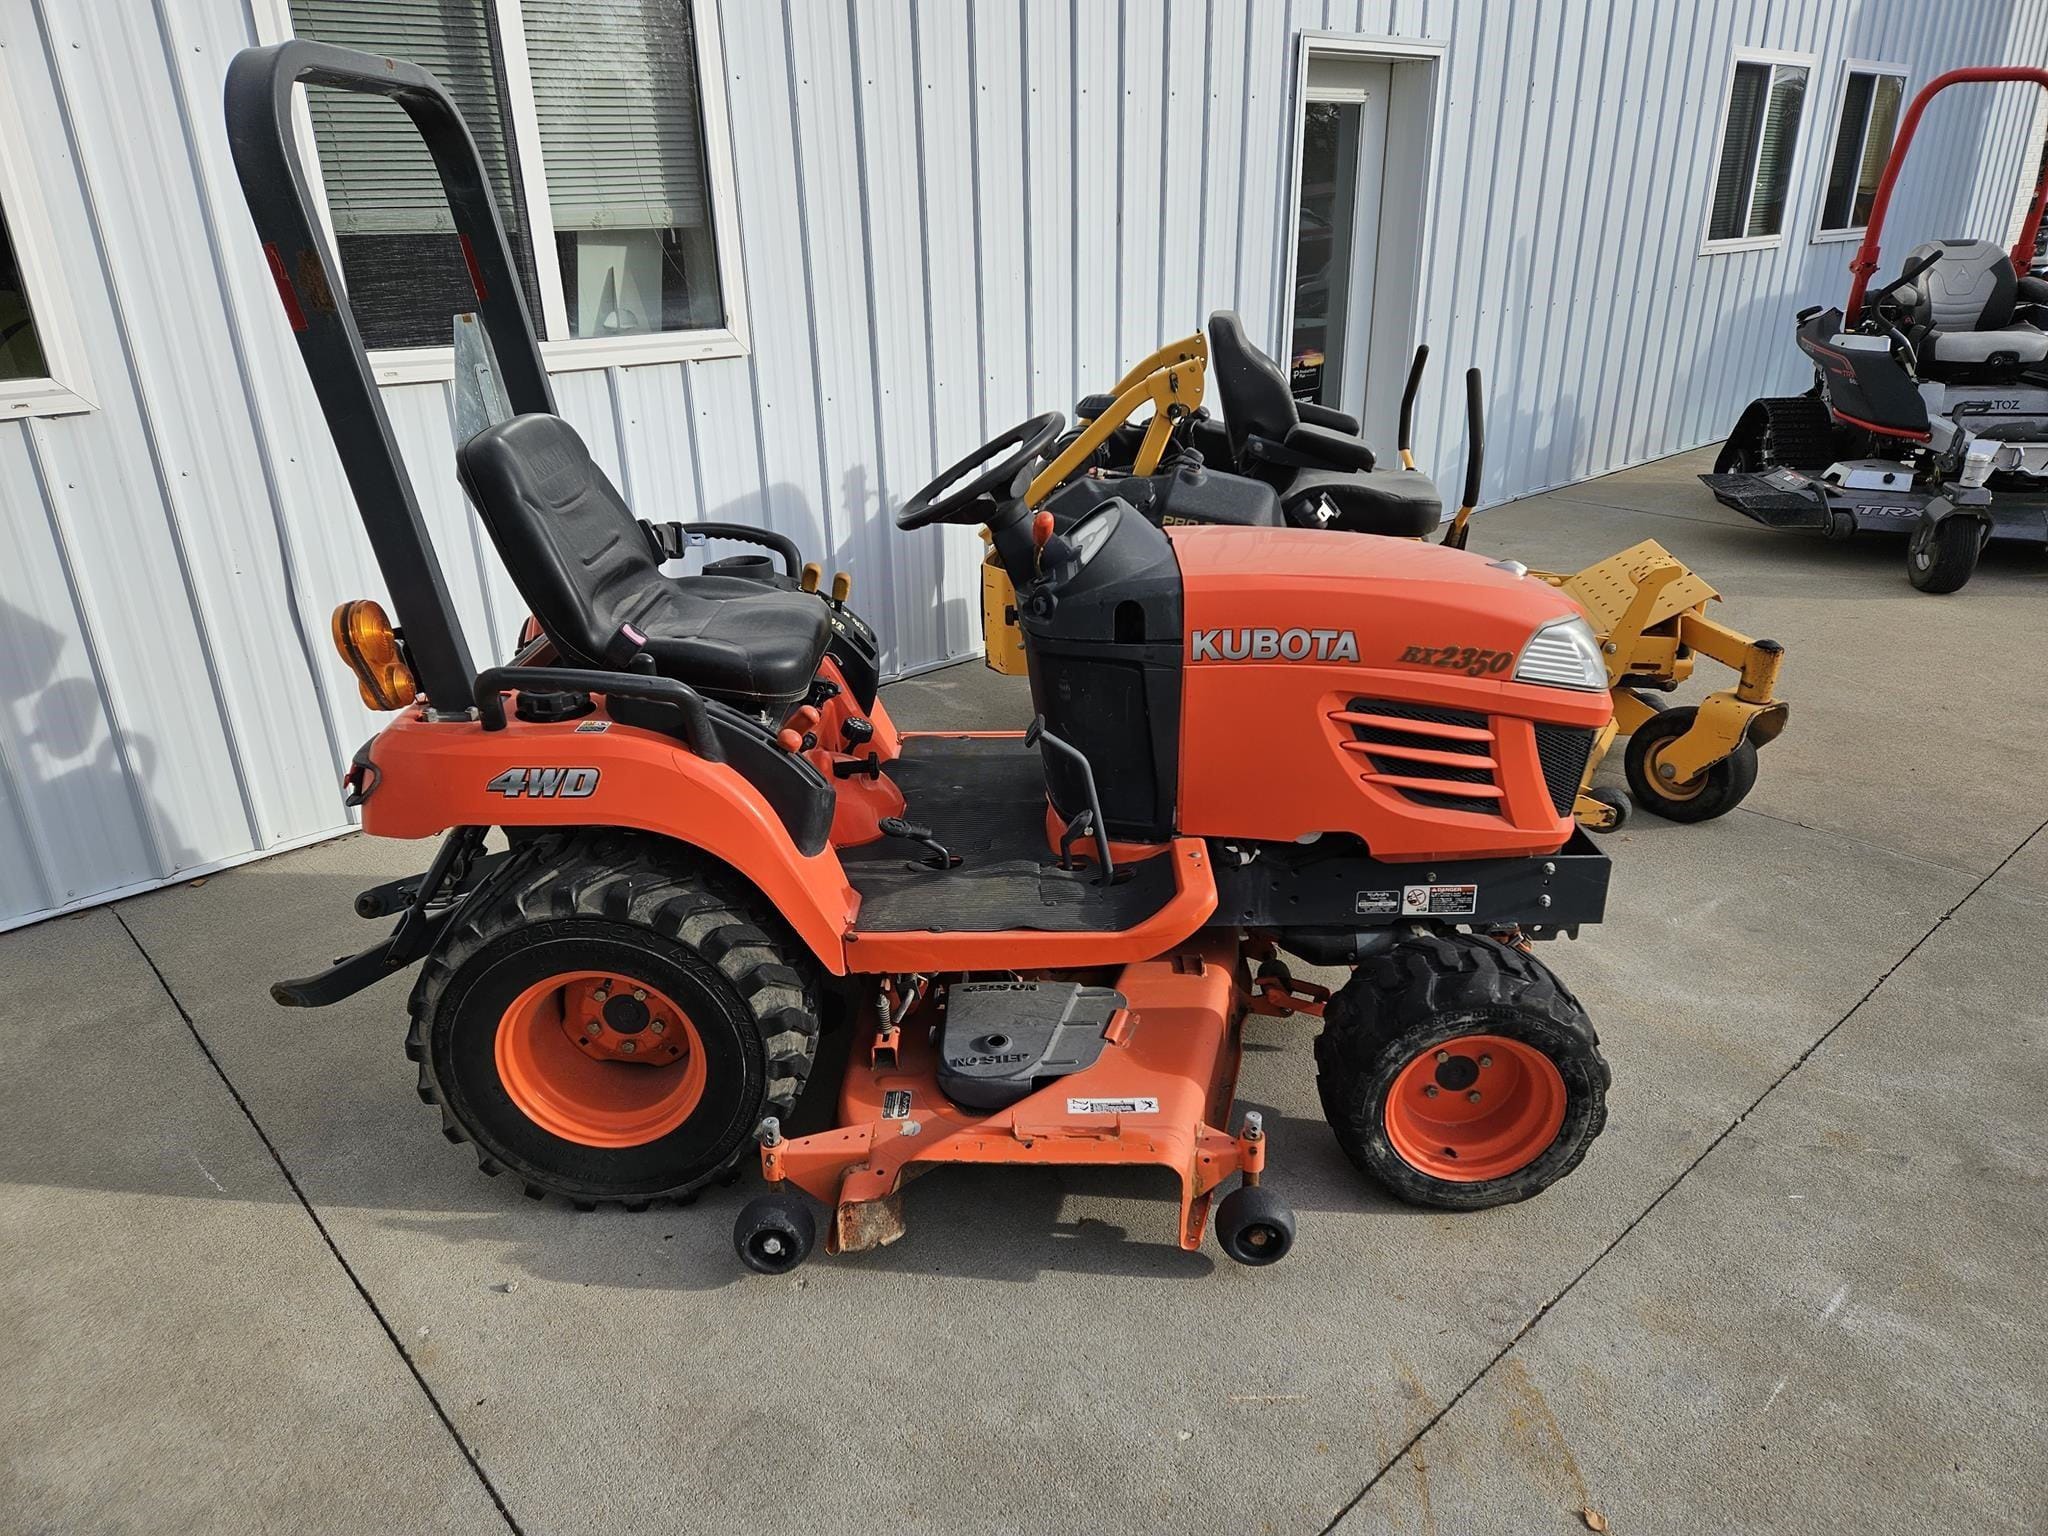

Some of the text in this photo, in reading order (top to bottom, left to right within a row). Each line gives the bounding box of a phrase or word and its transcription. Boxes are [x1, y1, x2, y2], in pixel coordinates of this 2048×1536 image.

[1856, 504, 1925, 518] TRX
[1191, 627, 1361, 663] KUBOTA
[1395, 645, 1514, 676] BX2350
[486, 766, 601, 799] 4WD
